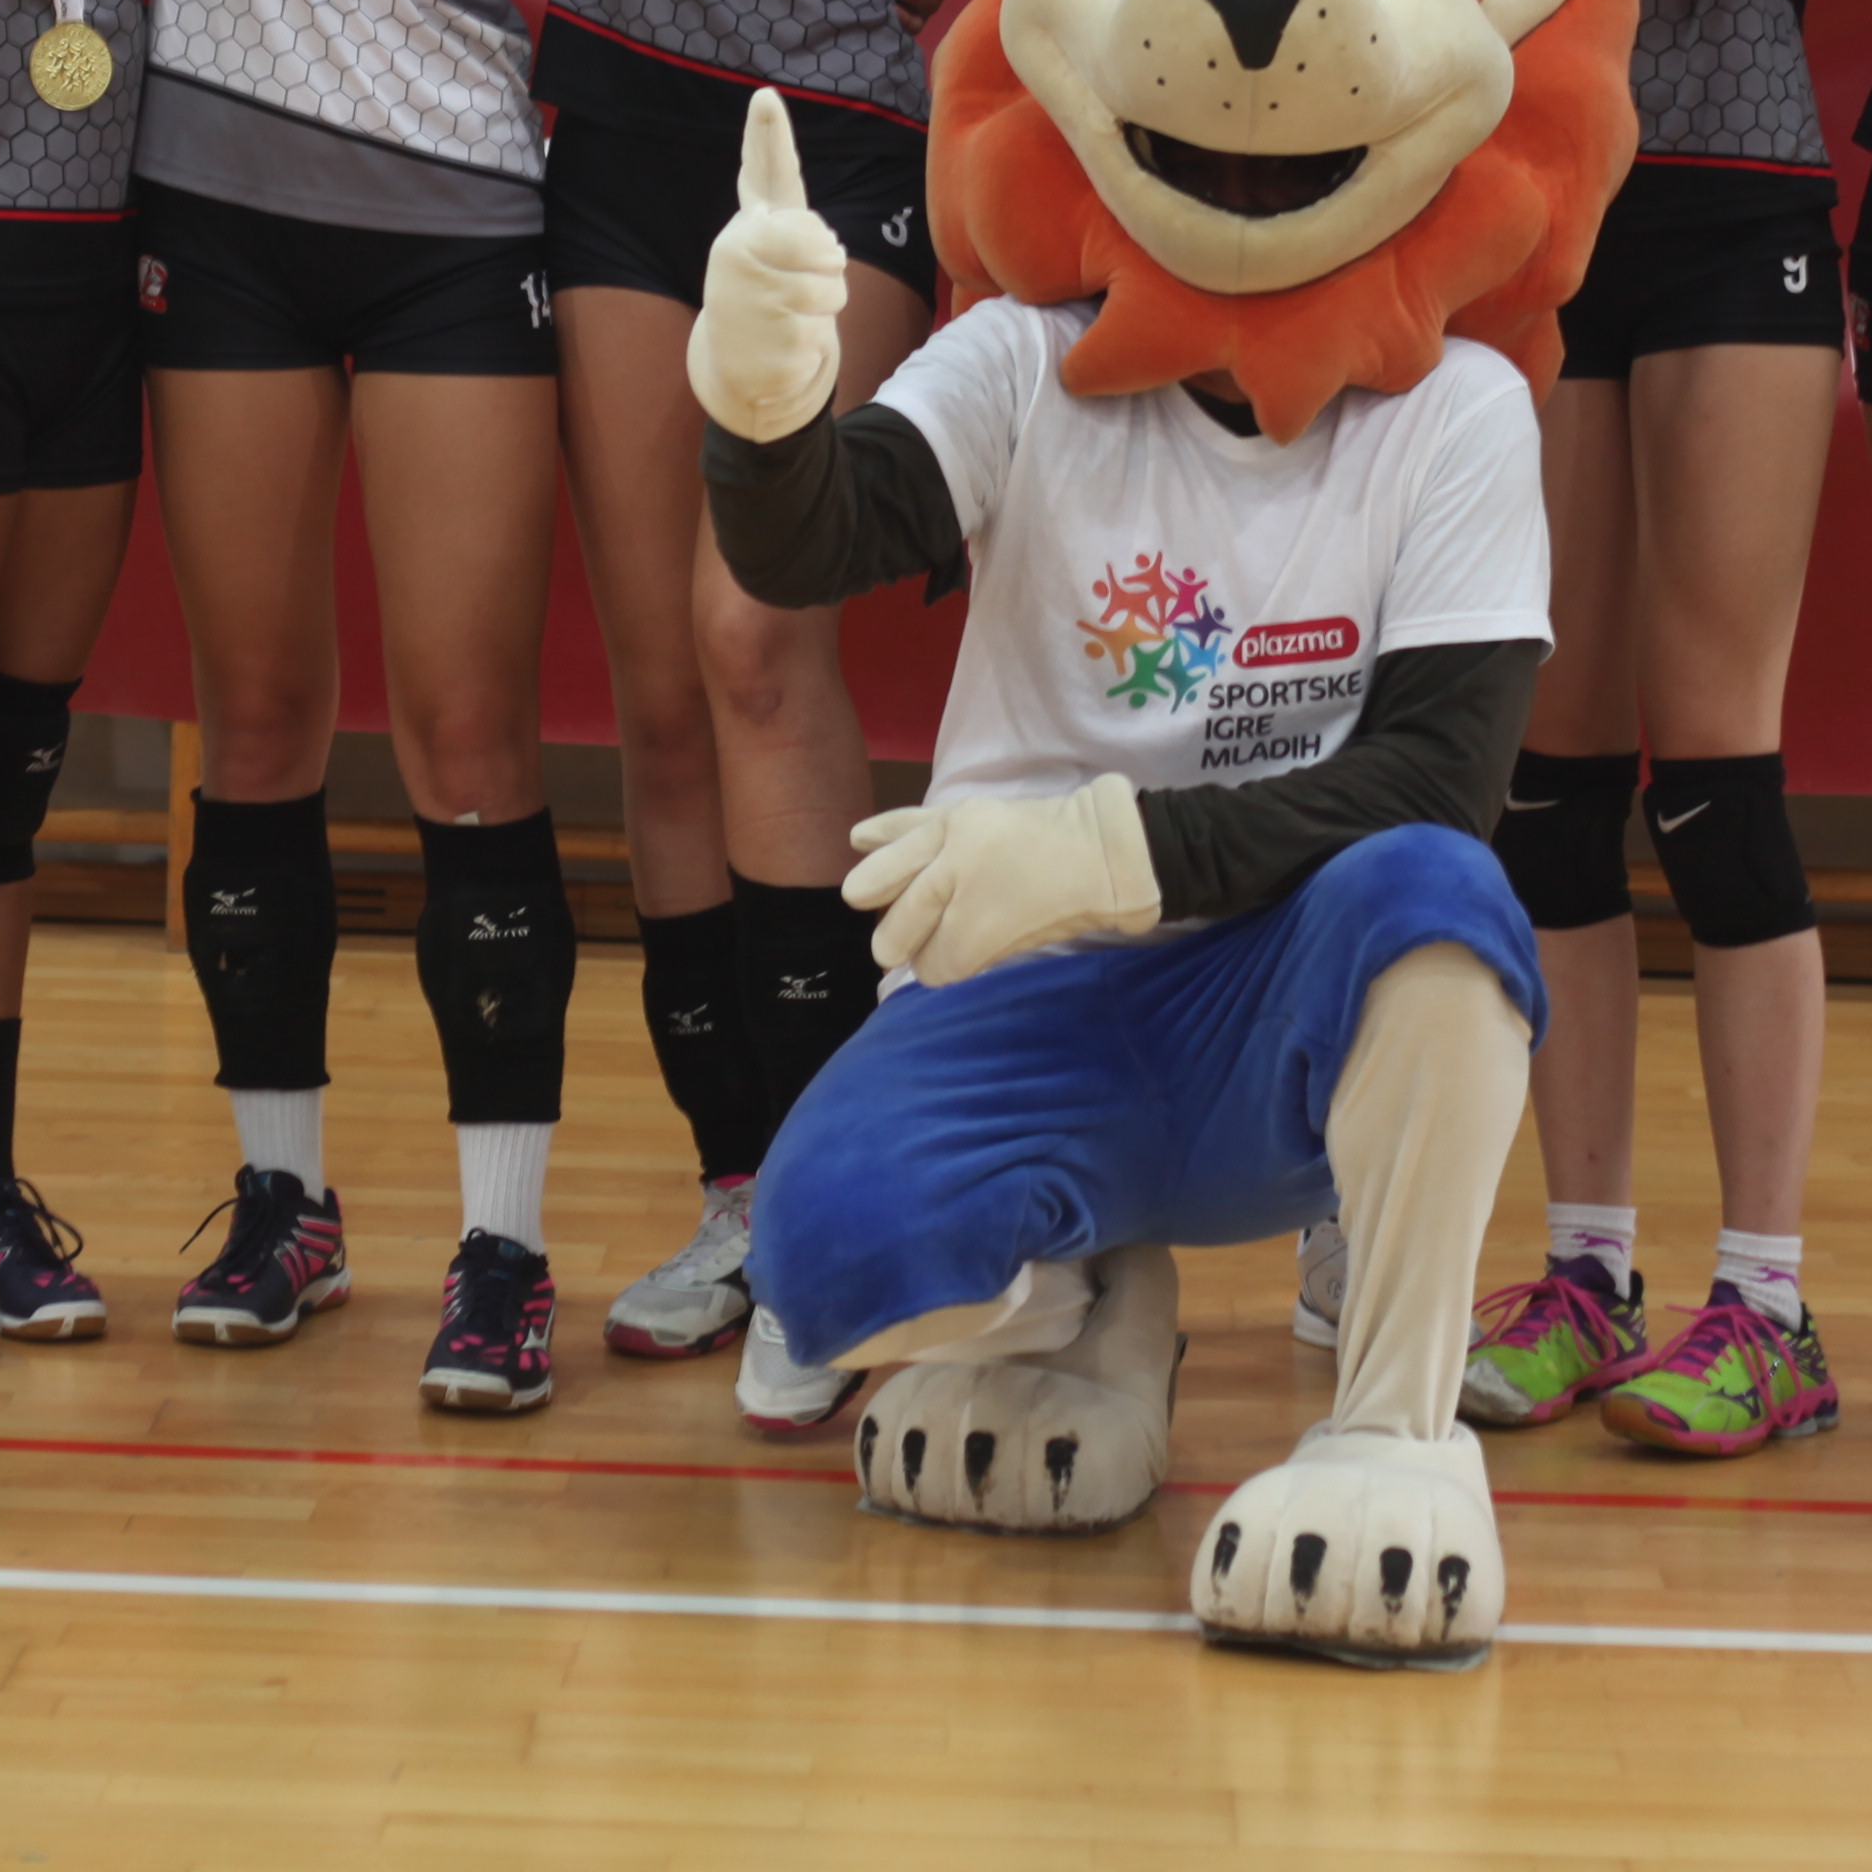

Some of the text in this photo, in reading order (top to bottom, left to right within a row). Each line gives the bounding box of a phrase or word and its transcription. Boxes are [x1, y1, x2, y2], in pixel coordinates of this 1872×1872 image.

[1241, 627, 1345, 664] plazma
[1208, 670, 1364, 710] SPORTSKE
[1204, 713, 1276, 740] IGRE
[1200, 734, 1322, 770] MLADIH
